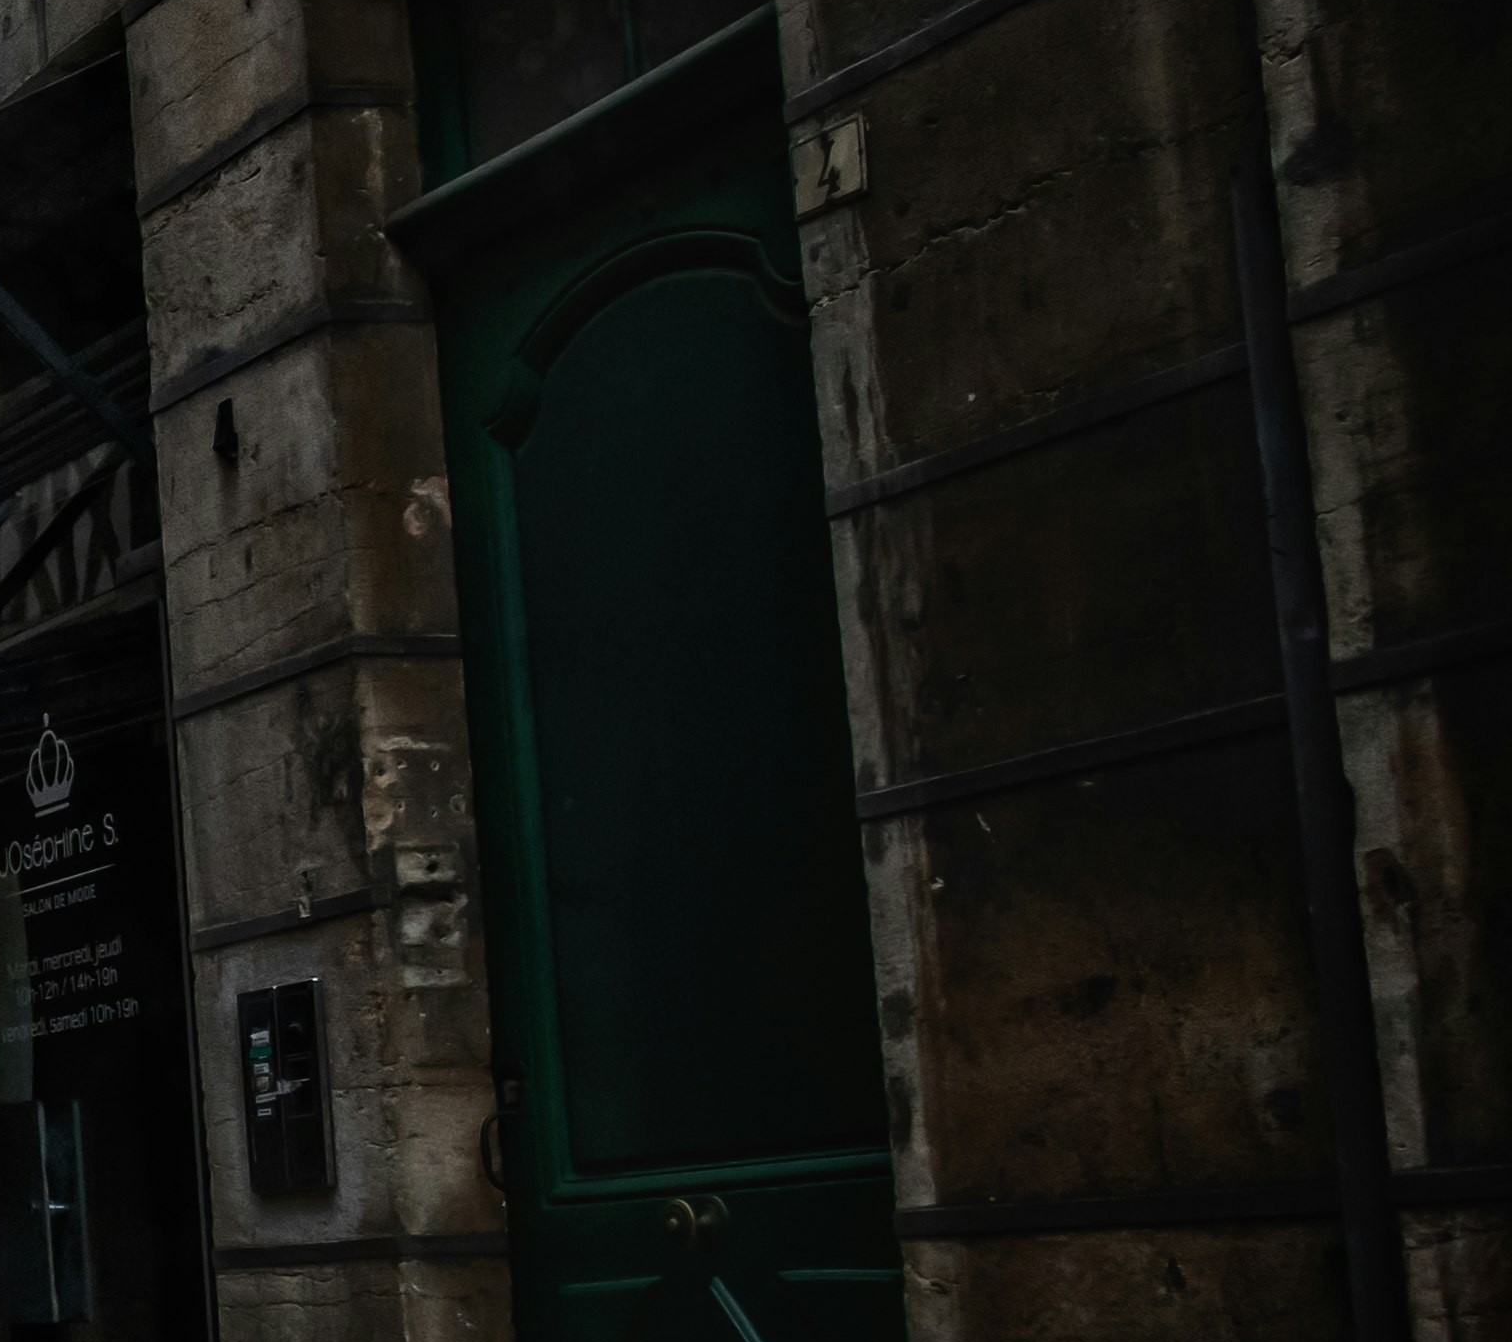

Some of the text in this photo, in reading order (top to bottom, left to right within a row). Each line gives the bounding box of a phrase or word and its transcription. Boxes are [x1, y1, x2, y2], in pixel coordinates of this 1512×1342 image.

[816, 132, 842, 200] 4
[102, 812, 120, 846] S.
[54, 892, 66, 909] DE
[67, 883, 97, 906] MODE
[90, 997, 139, 1025] 10h-19h
